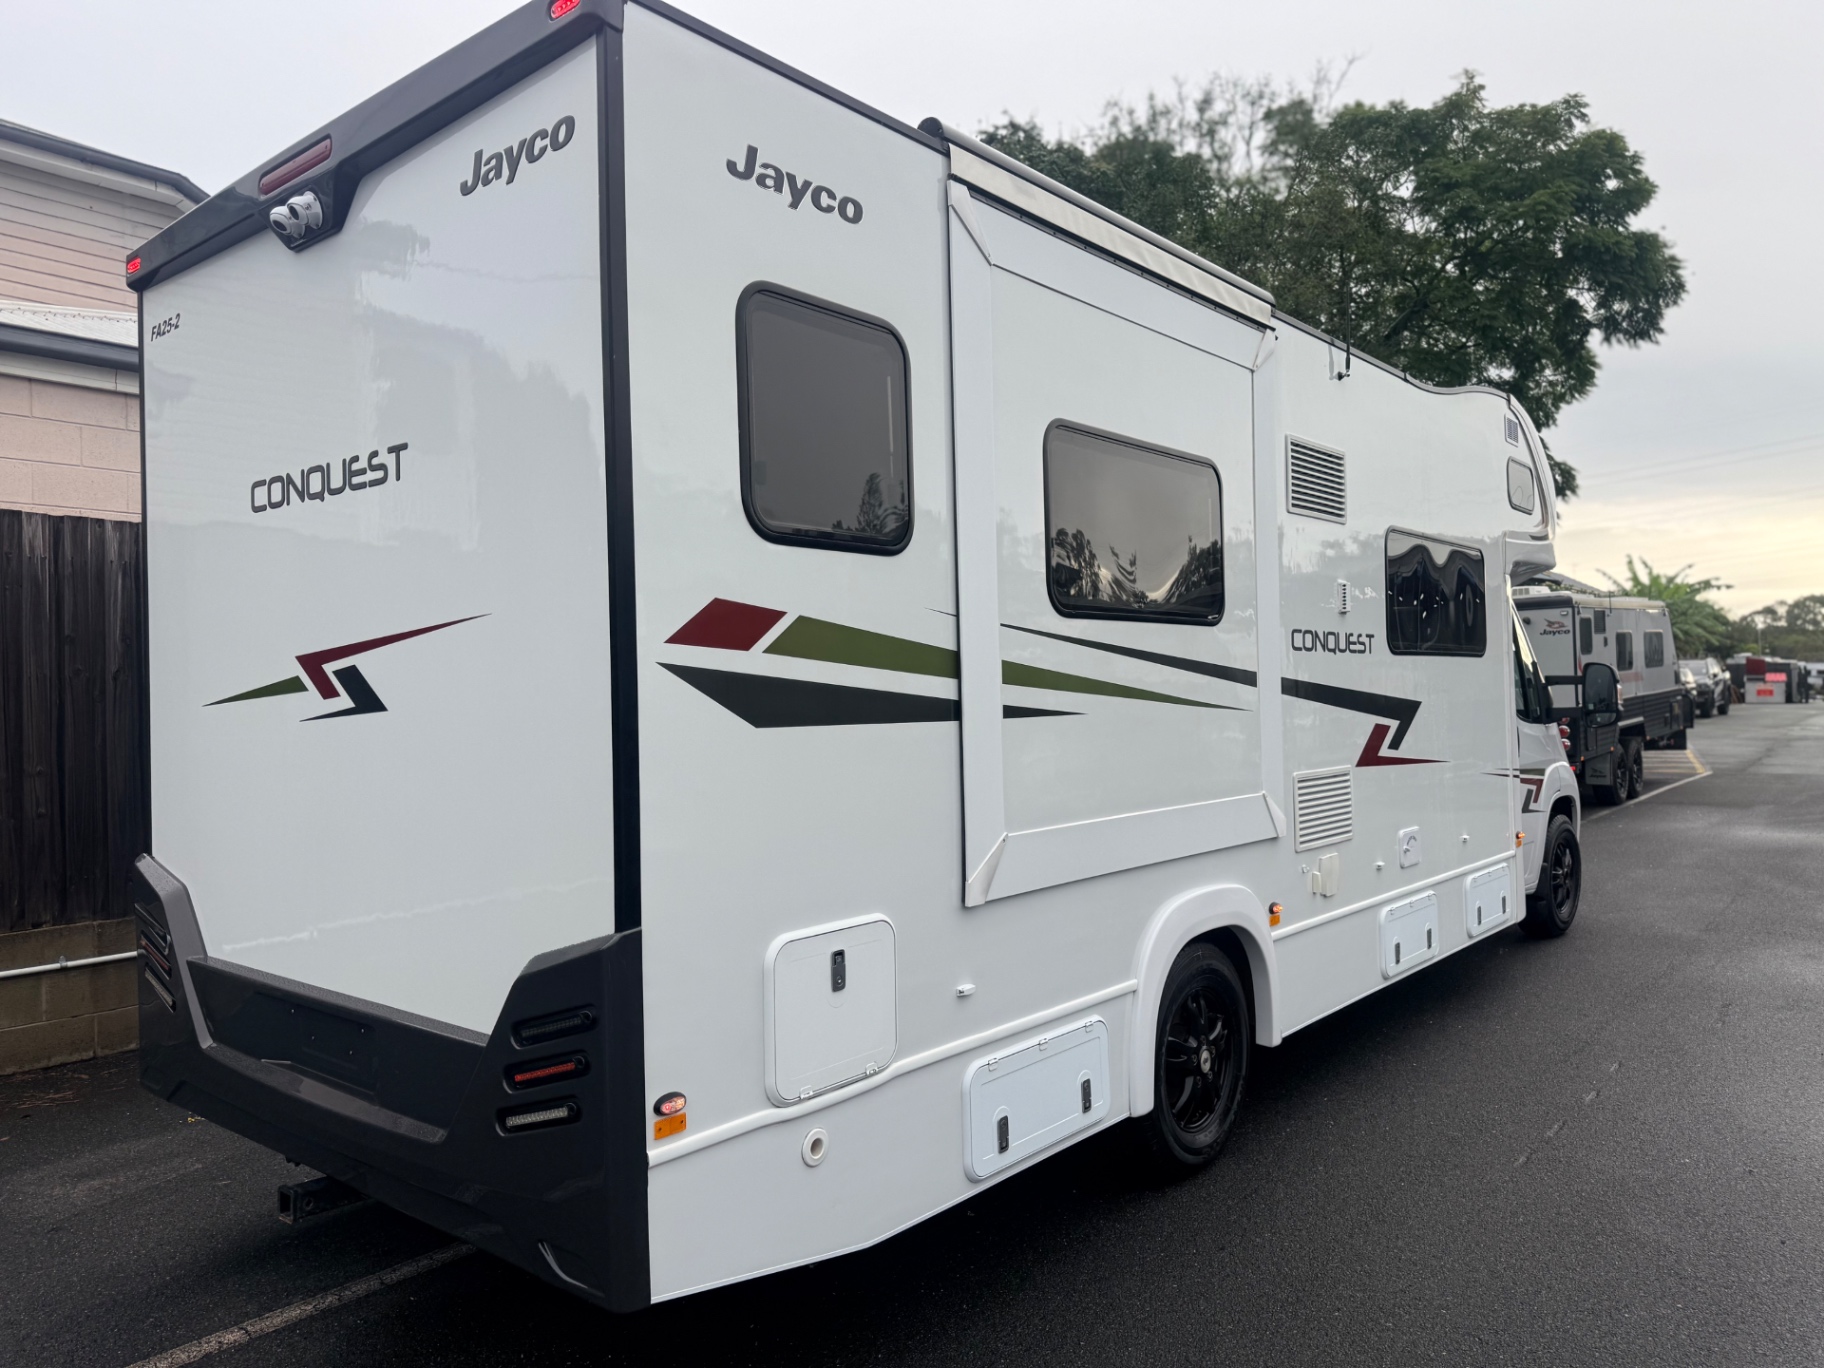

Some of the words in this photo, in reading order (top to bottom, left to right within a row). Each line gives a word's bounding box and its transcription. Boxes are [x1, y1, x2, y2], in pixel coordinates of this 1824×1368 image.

[460, 115, 576, 197] Jayco
[726, 143, 864, 225] Jayco
[150, 312, 181, 342] FA25-2
[250, 442, 408, 514] CONQUEST
[1291, 628, 1375, 655] CONQUEST
[1539, 628, 1571, 636] Jayco
